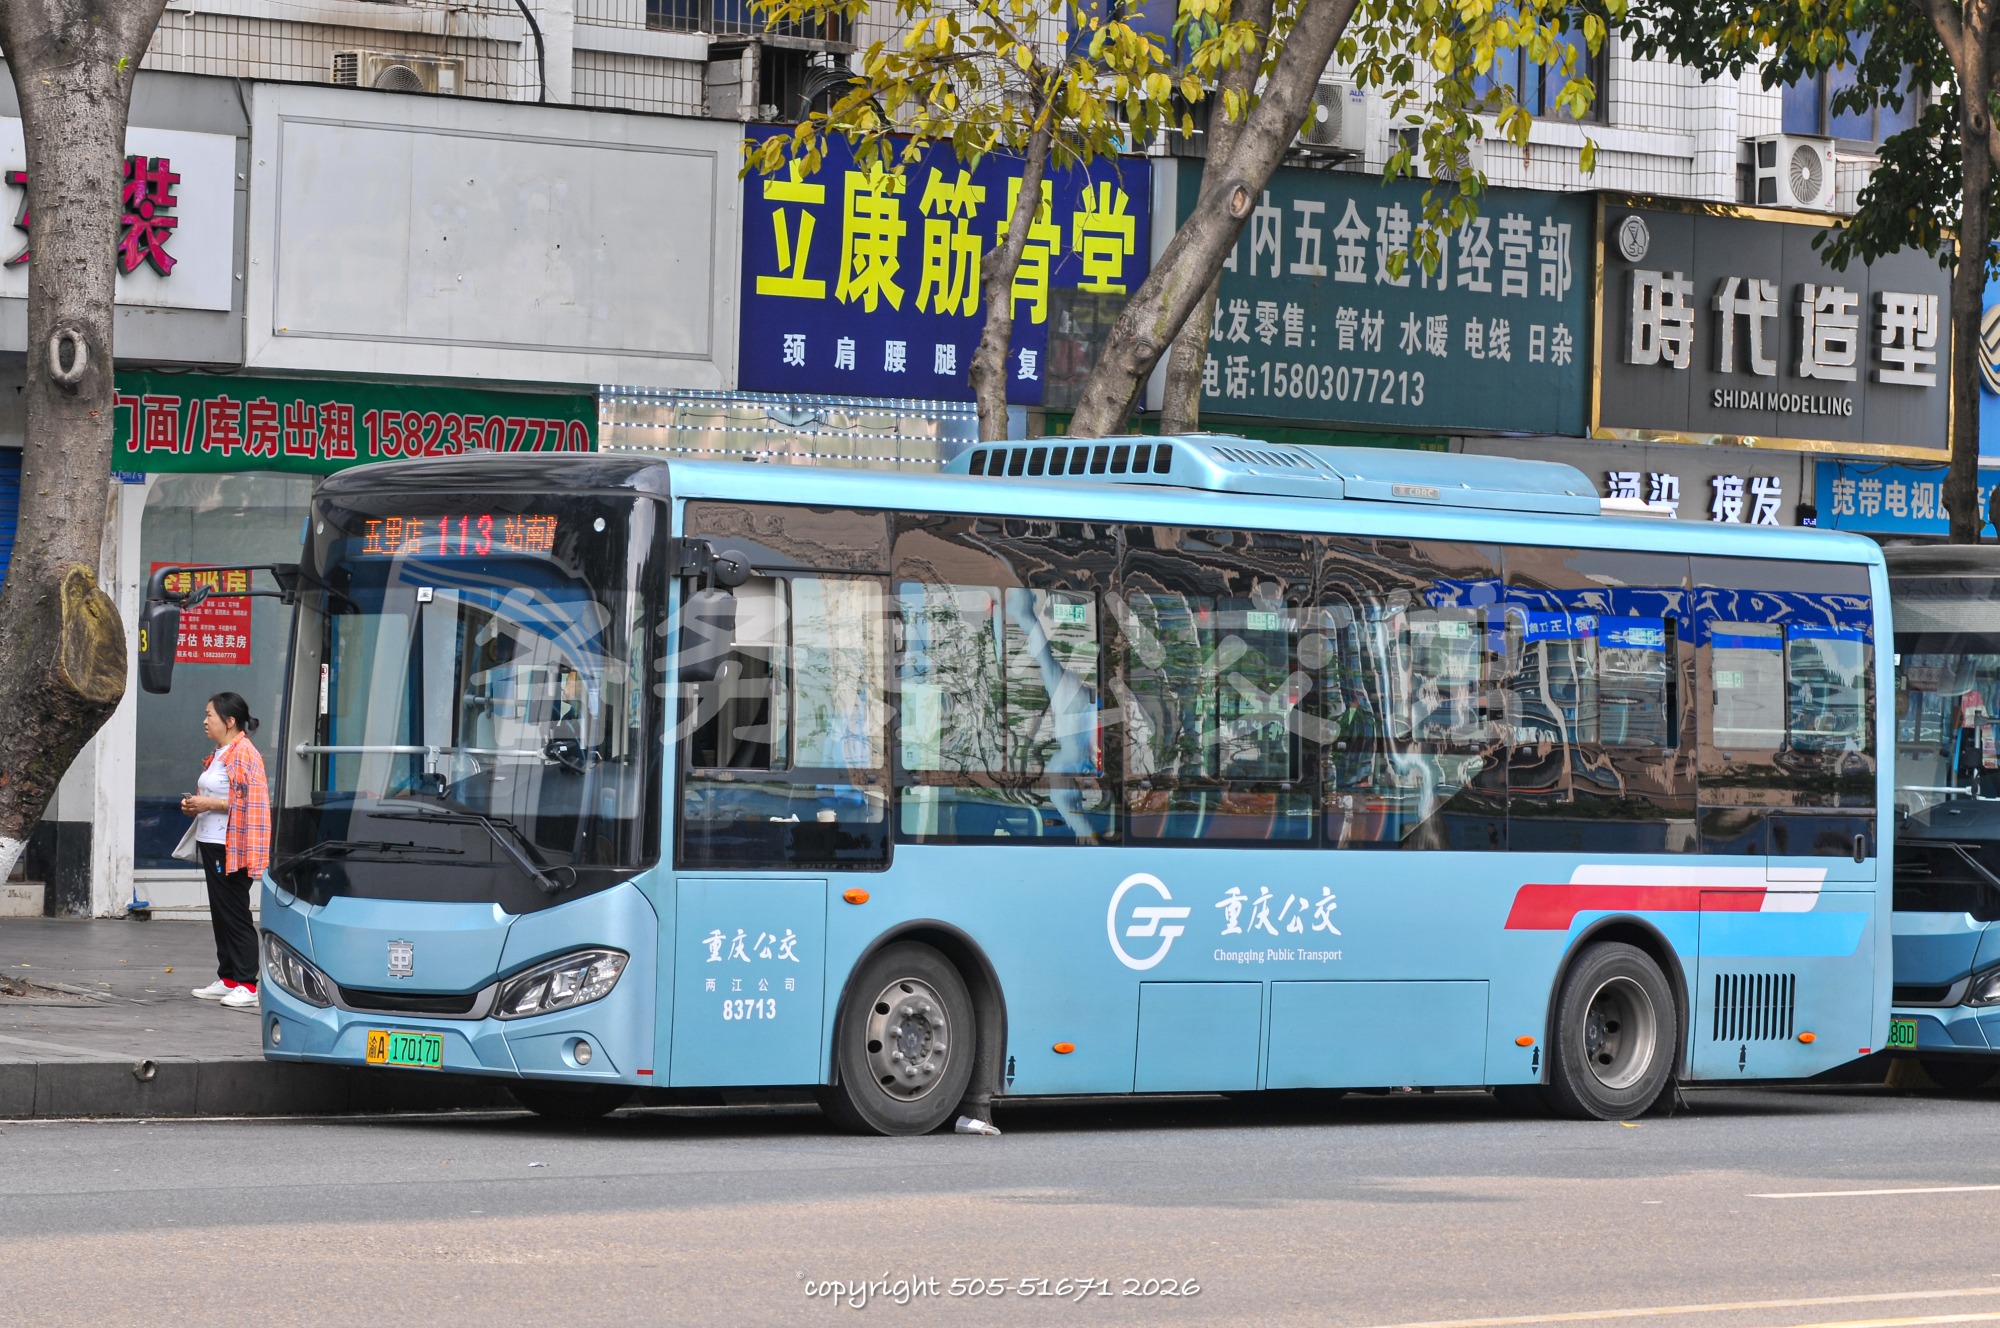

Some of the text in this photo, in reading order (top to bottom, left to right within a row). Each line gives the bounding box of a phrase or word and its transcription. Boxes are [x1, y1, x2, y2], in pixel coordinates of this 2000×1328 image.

[756, 158, 1135, 324] 立康筋骨堂
[1223, 190, 1572, 302] 内五金建材经营部
[1335, 306, 1385, 352] 管材
[1399, 312, 1448, 358] 水暖
[1465, 317, 1511, 362] 电线
[1529, 323, 1573, 366] 日杂
[1627, 269, 1939, 387] 時代造型
[1714, 389, 1853, 416] SHIDAI MODELLING
[1409, 488, 1434, 497] CRRC
[1712, 475, 1783, 525] 接发
[362, 517, 425, 555] 五里店
[437, 513, 494, 557] 113
[202, 634, 247, 648] 快速卖房
[1215, 886, 1342, 936] 重庆公交
[702, 929, 800, 963] 重庆公交
[1214, 948, 1342, 964] Chongqing Public Transport
[705, 978, 795, 992] 两江公司
[723, 998, 777, 1020] 83713
